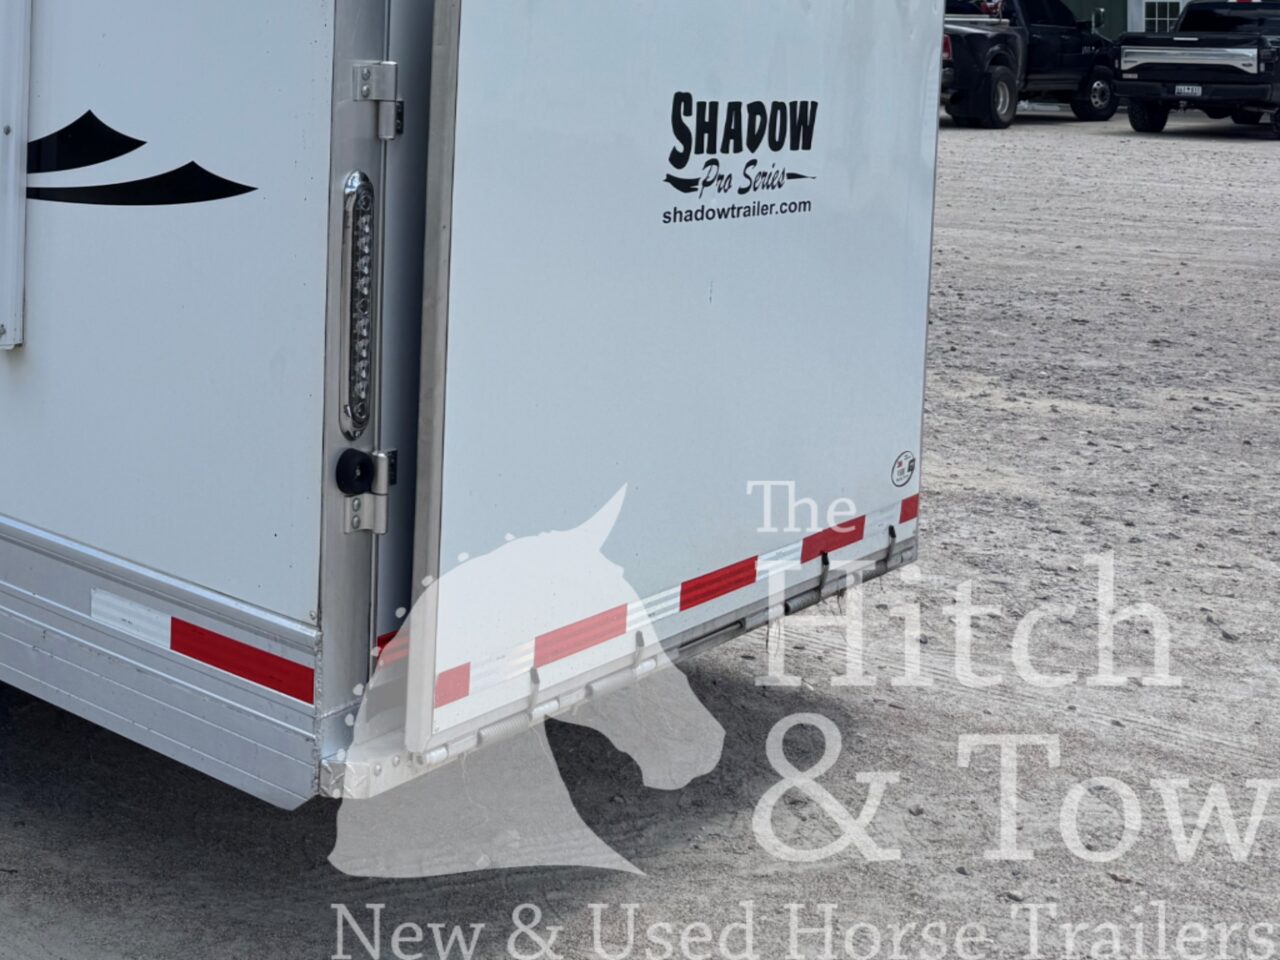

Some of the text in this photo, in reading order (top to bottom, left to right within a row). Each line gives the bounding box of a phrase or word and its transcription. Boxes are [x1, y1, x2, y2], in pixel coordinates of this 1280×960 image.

[668, 91, 819, 170] SHADOW
[698, 158, 786, 199] Pro Series
[662, 199, 812, 224] shadowtrailer.com
